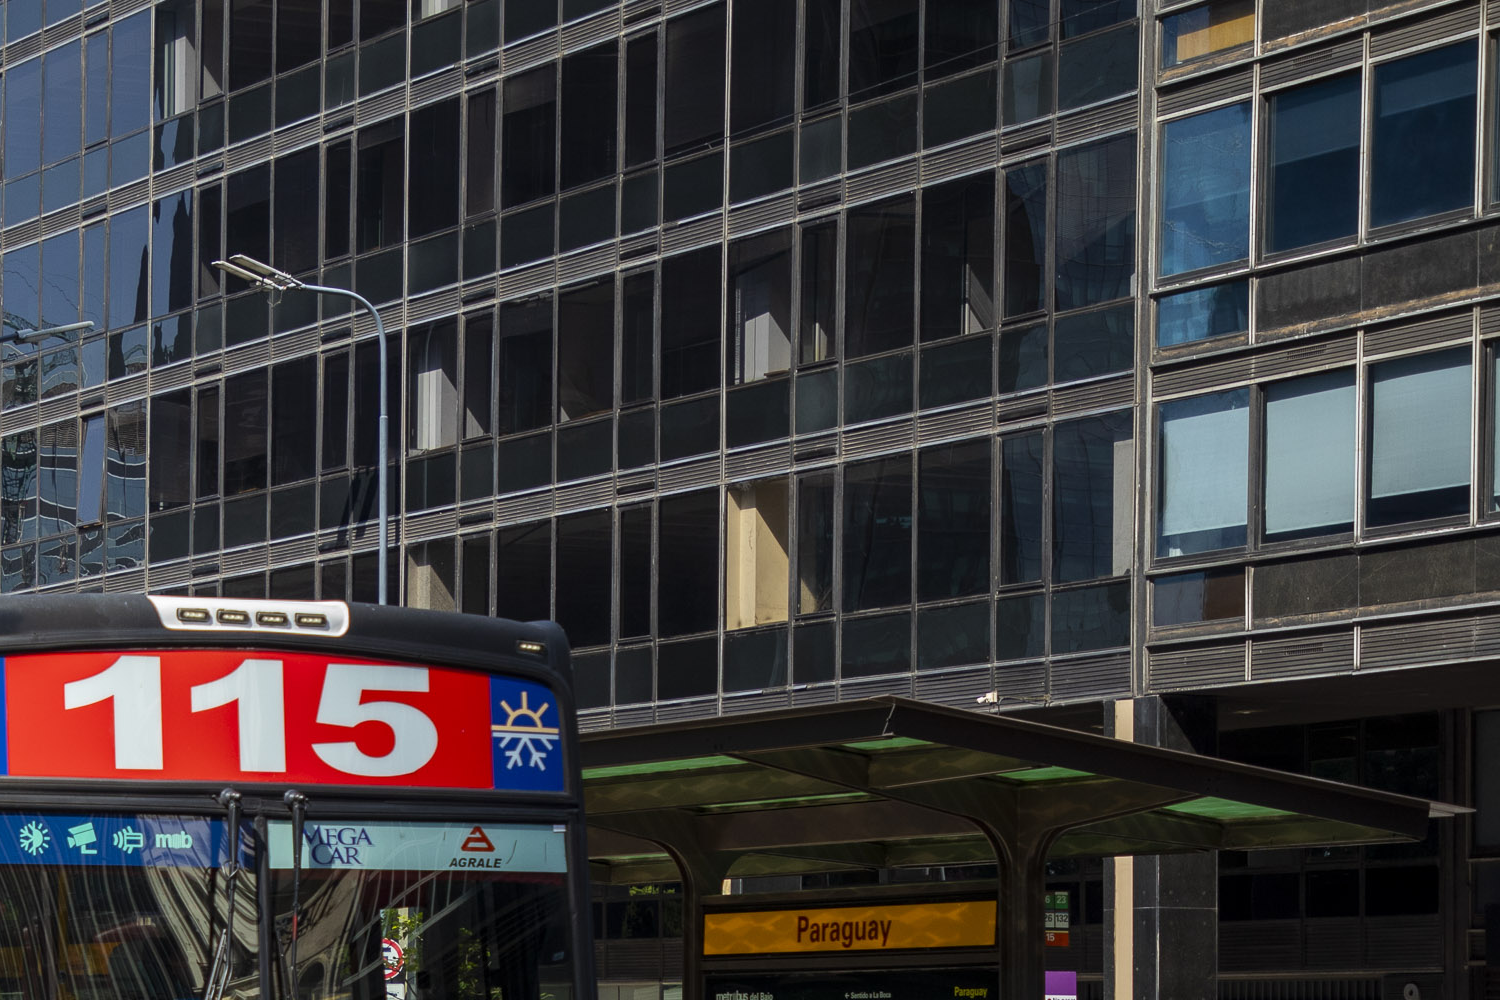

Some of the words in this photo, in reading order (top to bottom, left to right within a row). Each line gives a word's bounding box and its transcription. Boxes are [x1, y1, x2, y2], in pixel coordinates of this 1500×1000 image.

[64, 655, 438, 777] 115
[302, 825, 373, 846] MEGA
[311, 843, 362, 865] CAR
[449, 857, 503, 869] AGRALE
[1056, 895, 1067, 904] 23
[1055, 914, 1069, 923] 132
[797, 915, 892, 949] Paraguay
[750, 992, 759, 1000] del
[850, 992, 868, 1000] Sentido
[879, 991, 892, 999] Boca
[954, 986, 988, 998] Paraguay
